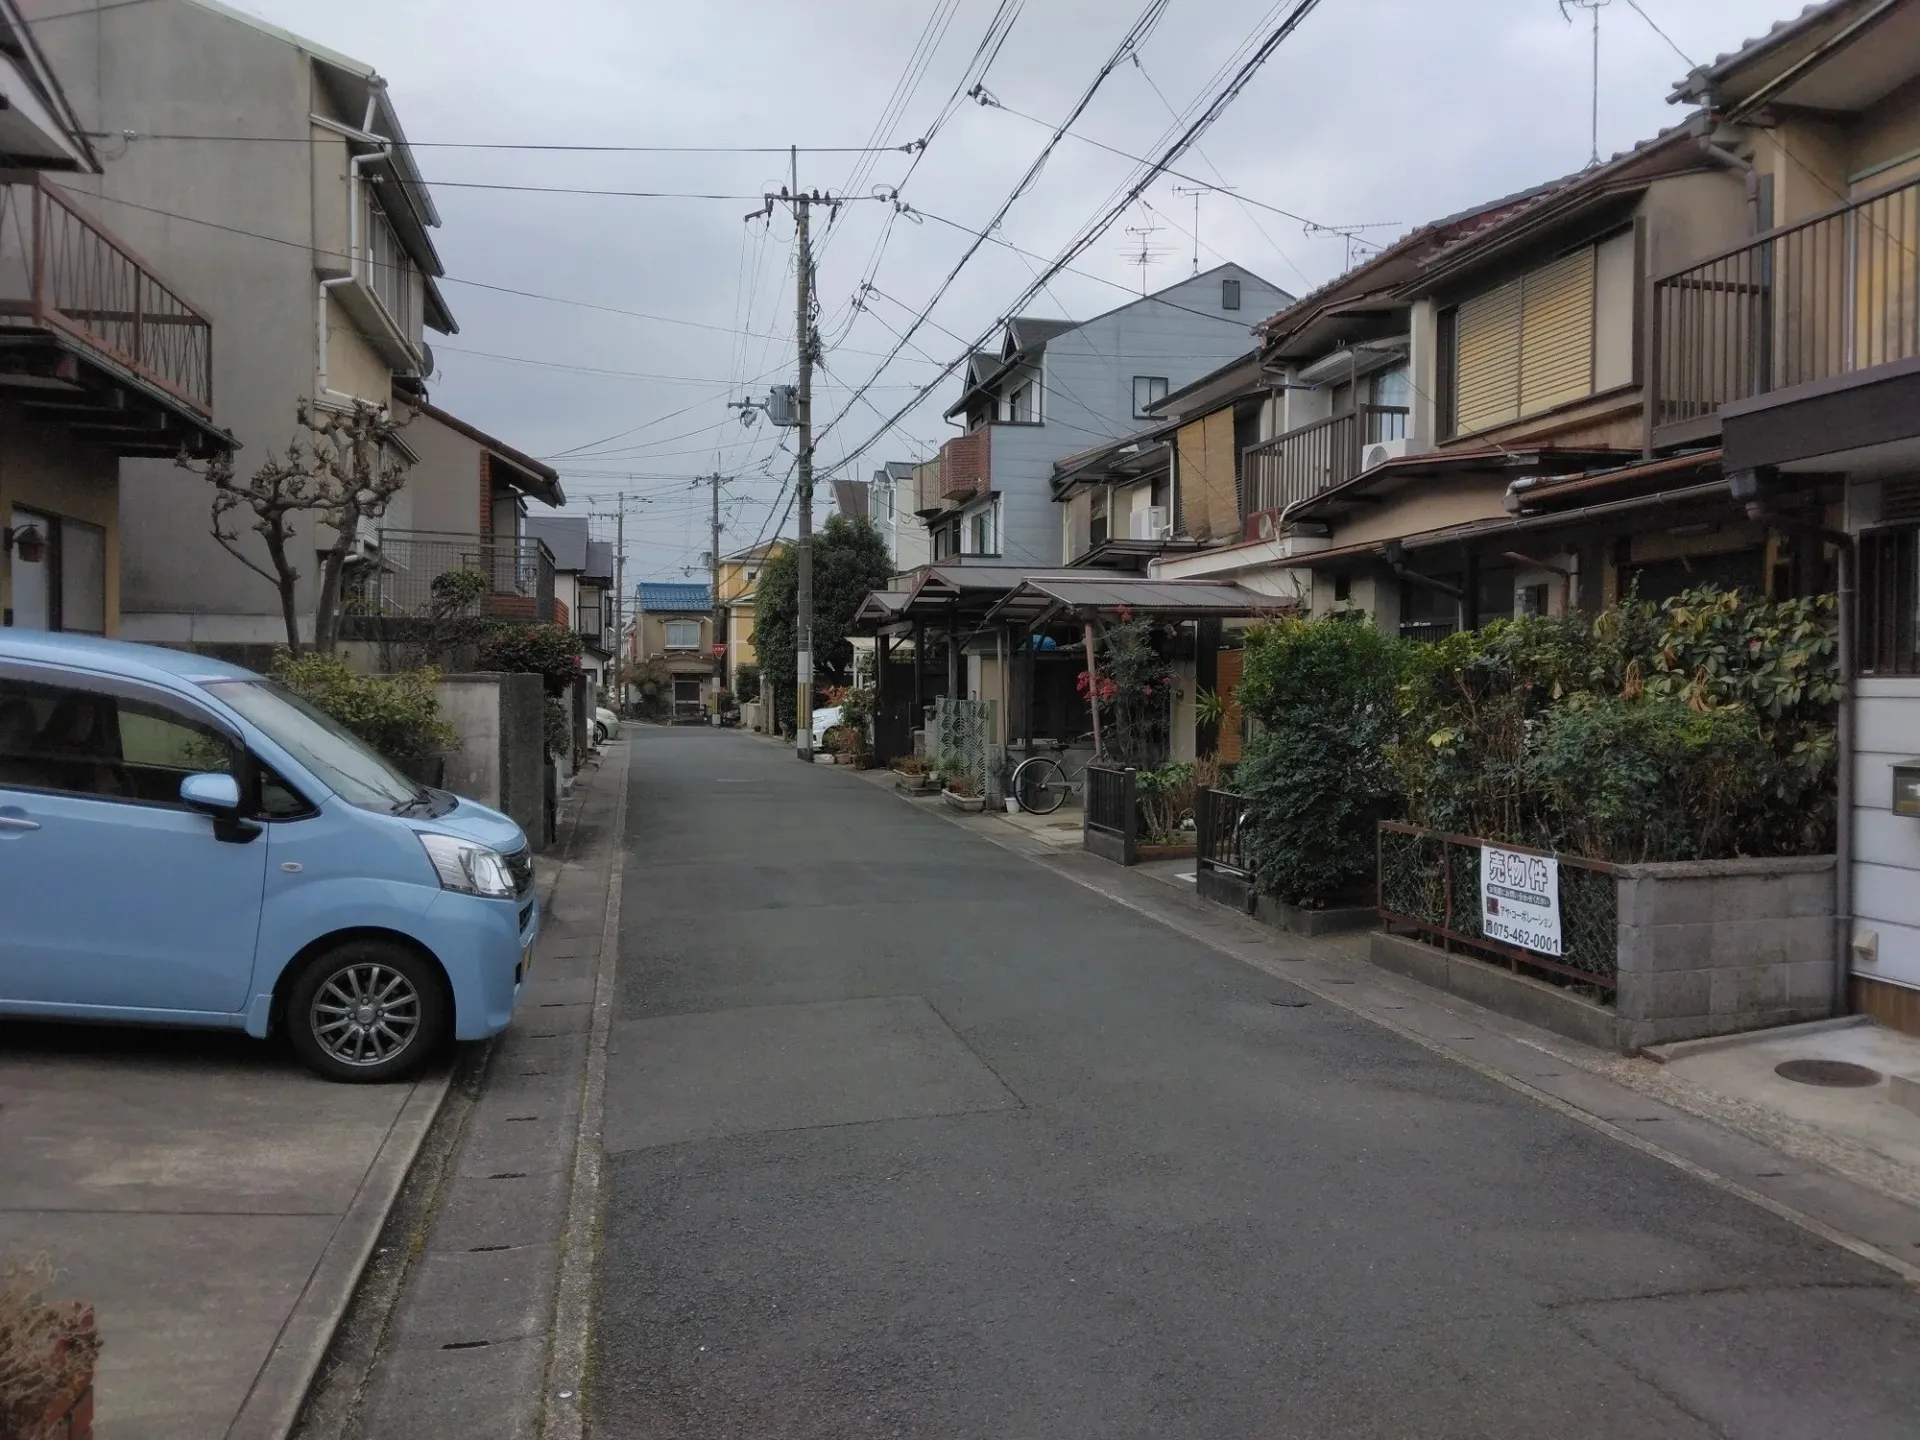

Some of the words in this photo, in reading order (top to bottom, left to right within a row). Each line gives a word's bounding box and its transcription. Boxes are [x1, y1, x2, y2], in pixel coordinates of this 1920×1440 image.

[1489, 851, 1548, 892] 売物件
[1493, 923, 1559, 953] 075-462-0001
